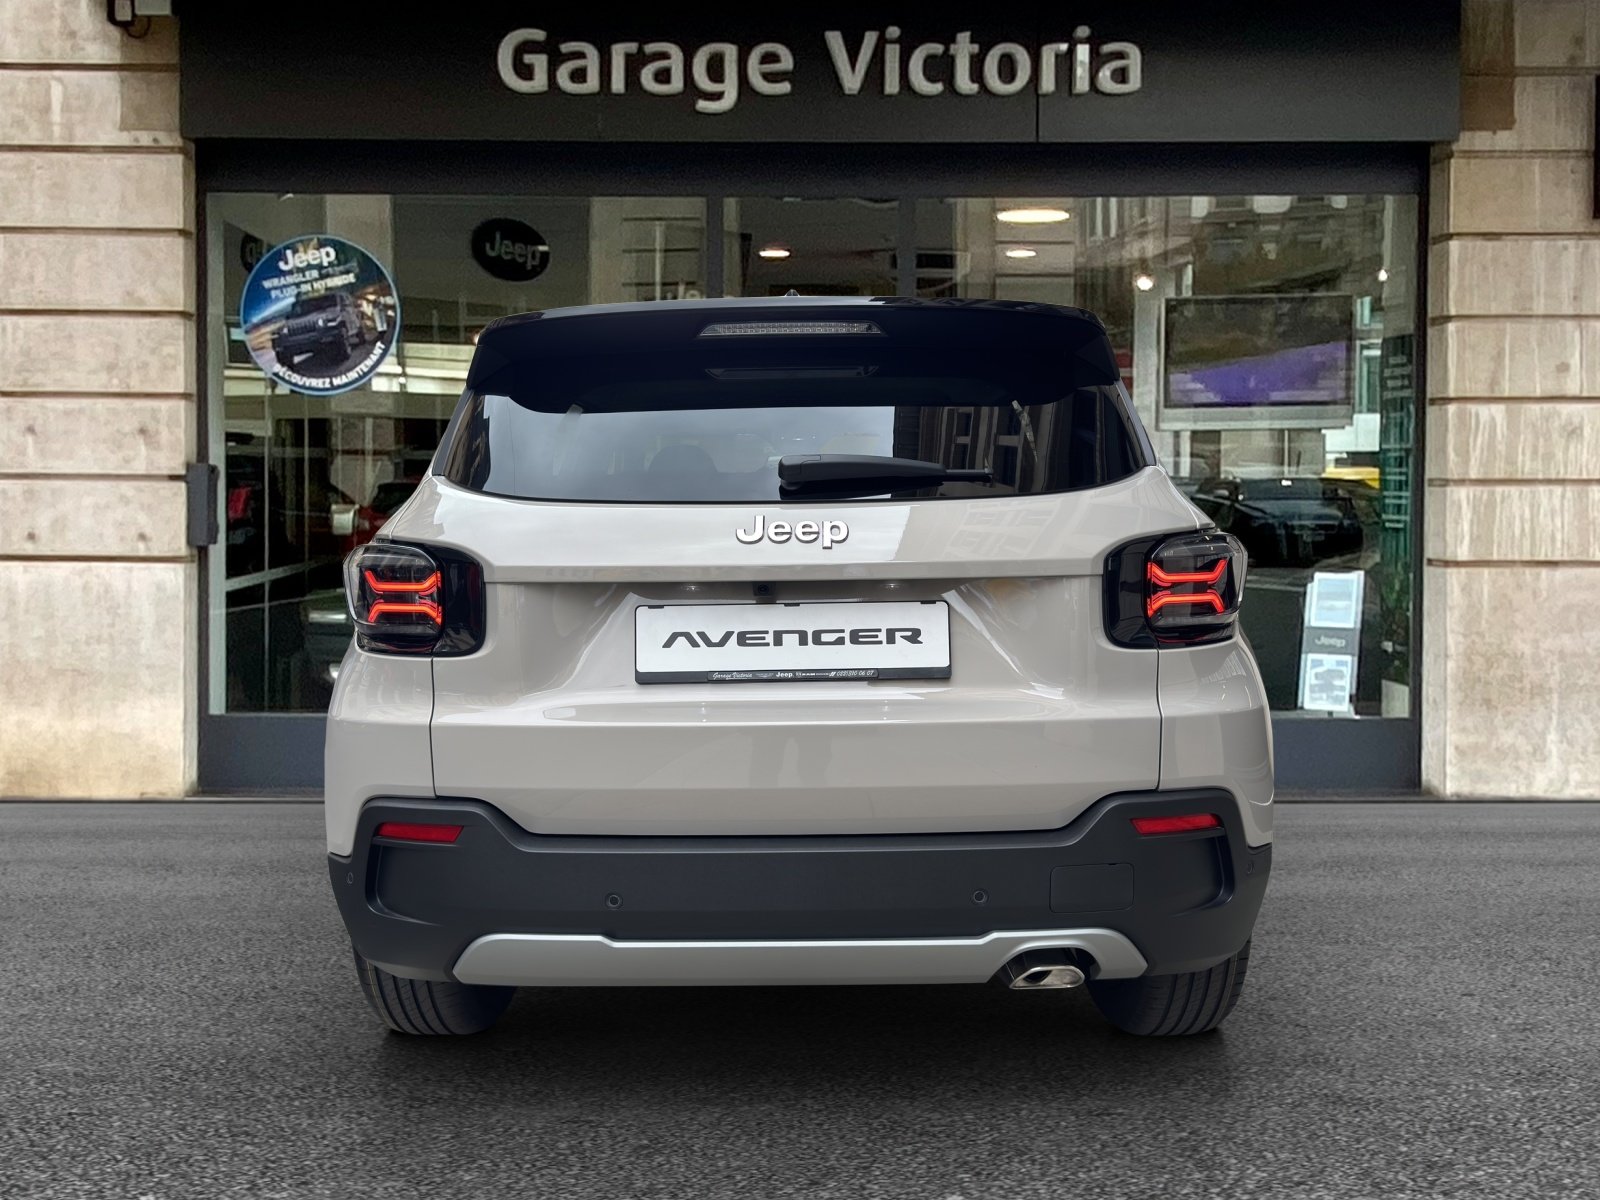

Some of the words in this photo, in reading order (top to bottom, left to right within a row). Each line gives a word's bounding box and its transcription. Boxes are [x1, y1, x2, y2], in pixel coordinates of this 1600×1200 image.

[497, 27, 795, 114] Garage
[823, 25, 1142, 96] Victoria
[278, 246, 337, 271] Jeep
[485, 231, 541, 271] Jeep
[262, 269, 320, 289] WRANGLER
[272, 362, 331, 388] DÉCOUVREZ
[332, 341, 386, 386] MAINTENANT
[735, 515, 849, 550] Jeep
[661, 627, 924, 648] AVENGER
[1314, 635, 1346, 648] Jeep
